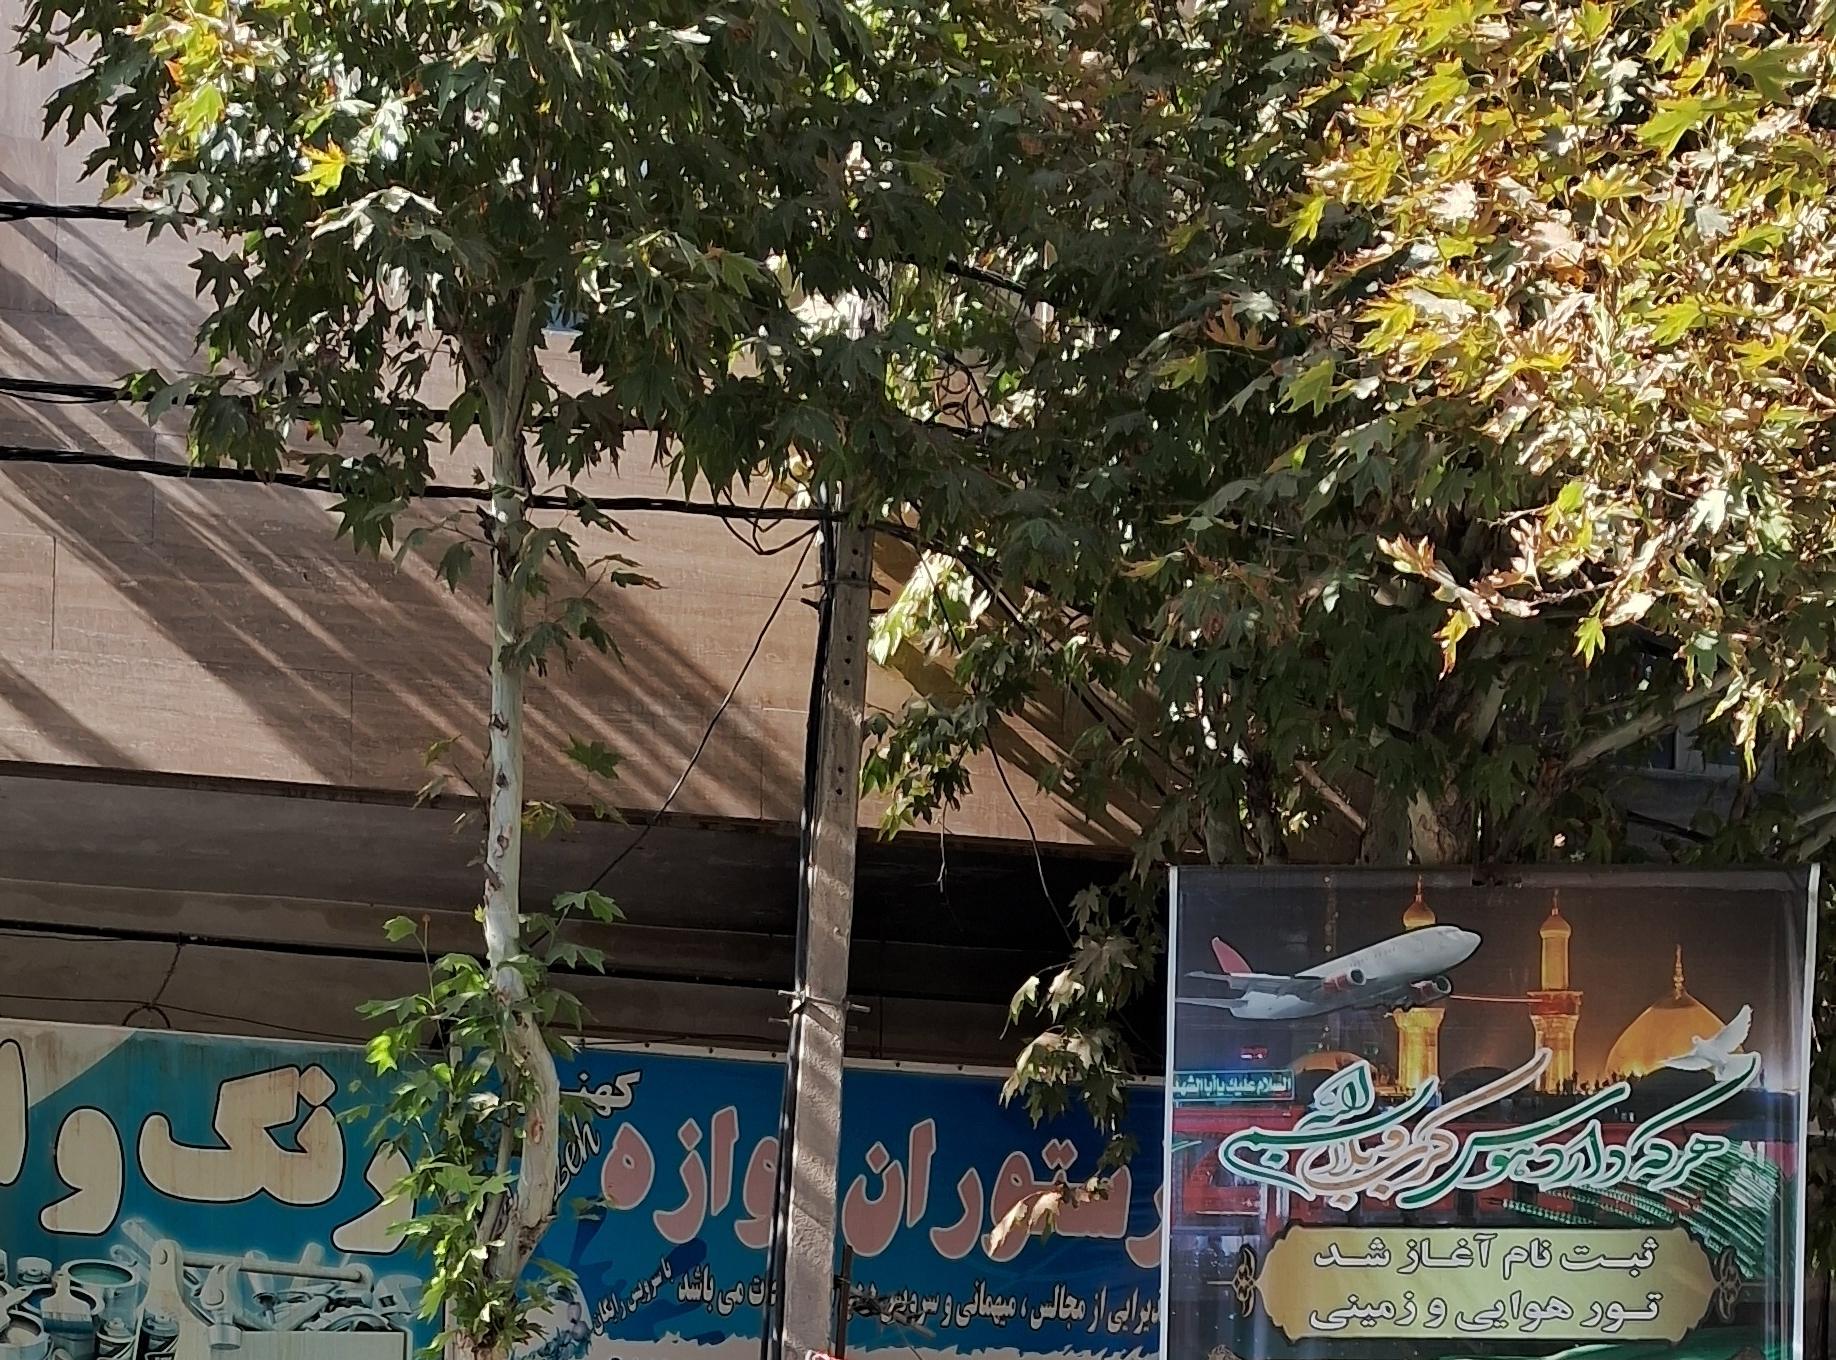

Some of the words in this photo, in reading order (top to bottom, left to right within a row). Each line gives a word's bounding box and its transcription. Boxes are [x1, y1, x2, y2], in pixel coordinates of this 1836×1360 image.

[38, 1106, 125, 1236] و
[136, 1064, 418, 1256] رنگ
[1312, 1234, 1392, 1270] شد
[1404, 1232, 1498, 1276] آغاز
[1501, 1237, 1557, 1280] نام
[1560, 1235, 1657, 1272] ثبت
[678, 1264, 714, 1311] باشد
[718, 1281, 744, 1315] می
[955, 1279, 1015, 1327] میهمانی
[1030, 1284, 1086, 1330] مجالس
[940, 1292, 952, 1327] و
[1087, 1285, 1107, 1333] از
[1308, 1291, 1418, 1332] زمینی
[1425, 1297, 1448, 1330] و
[1454, 1290, 1573, 1332] هوایی
[1578, 1294, 1663, 1331] تور
